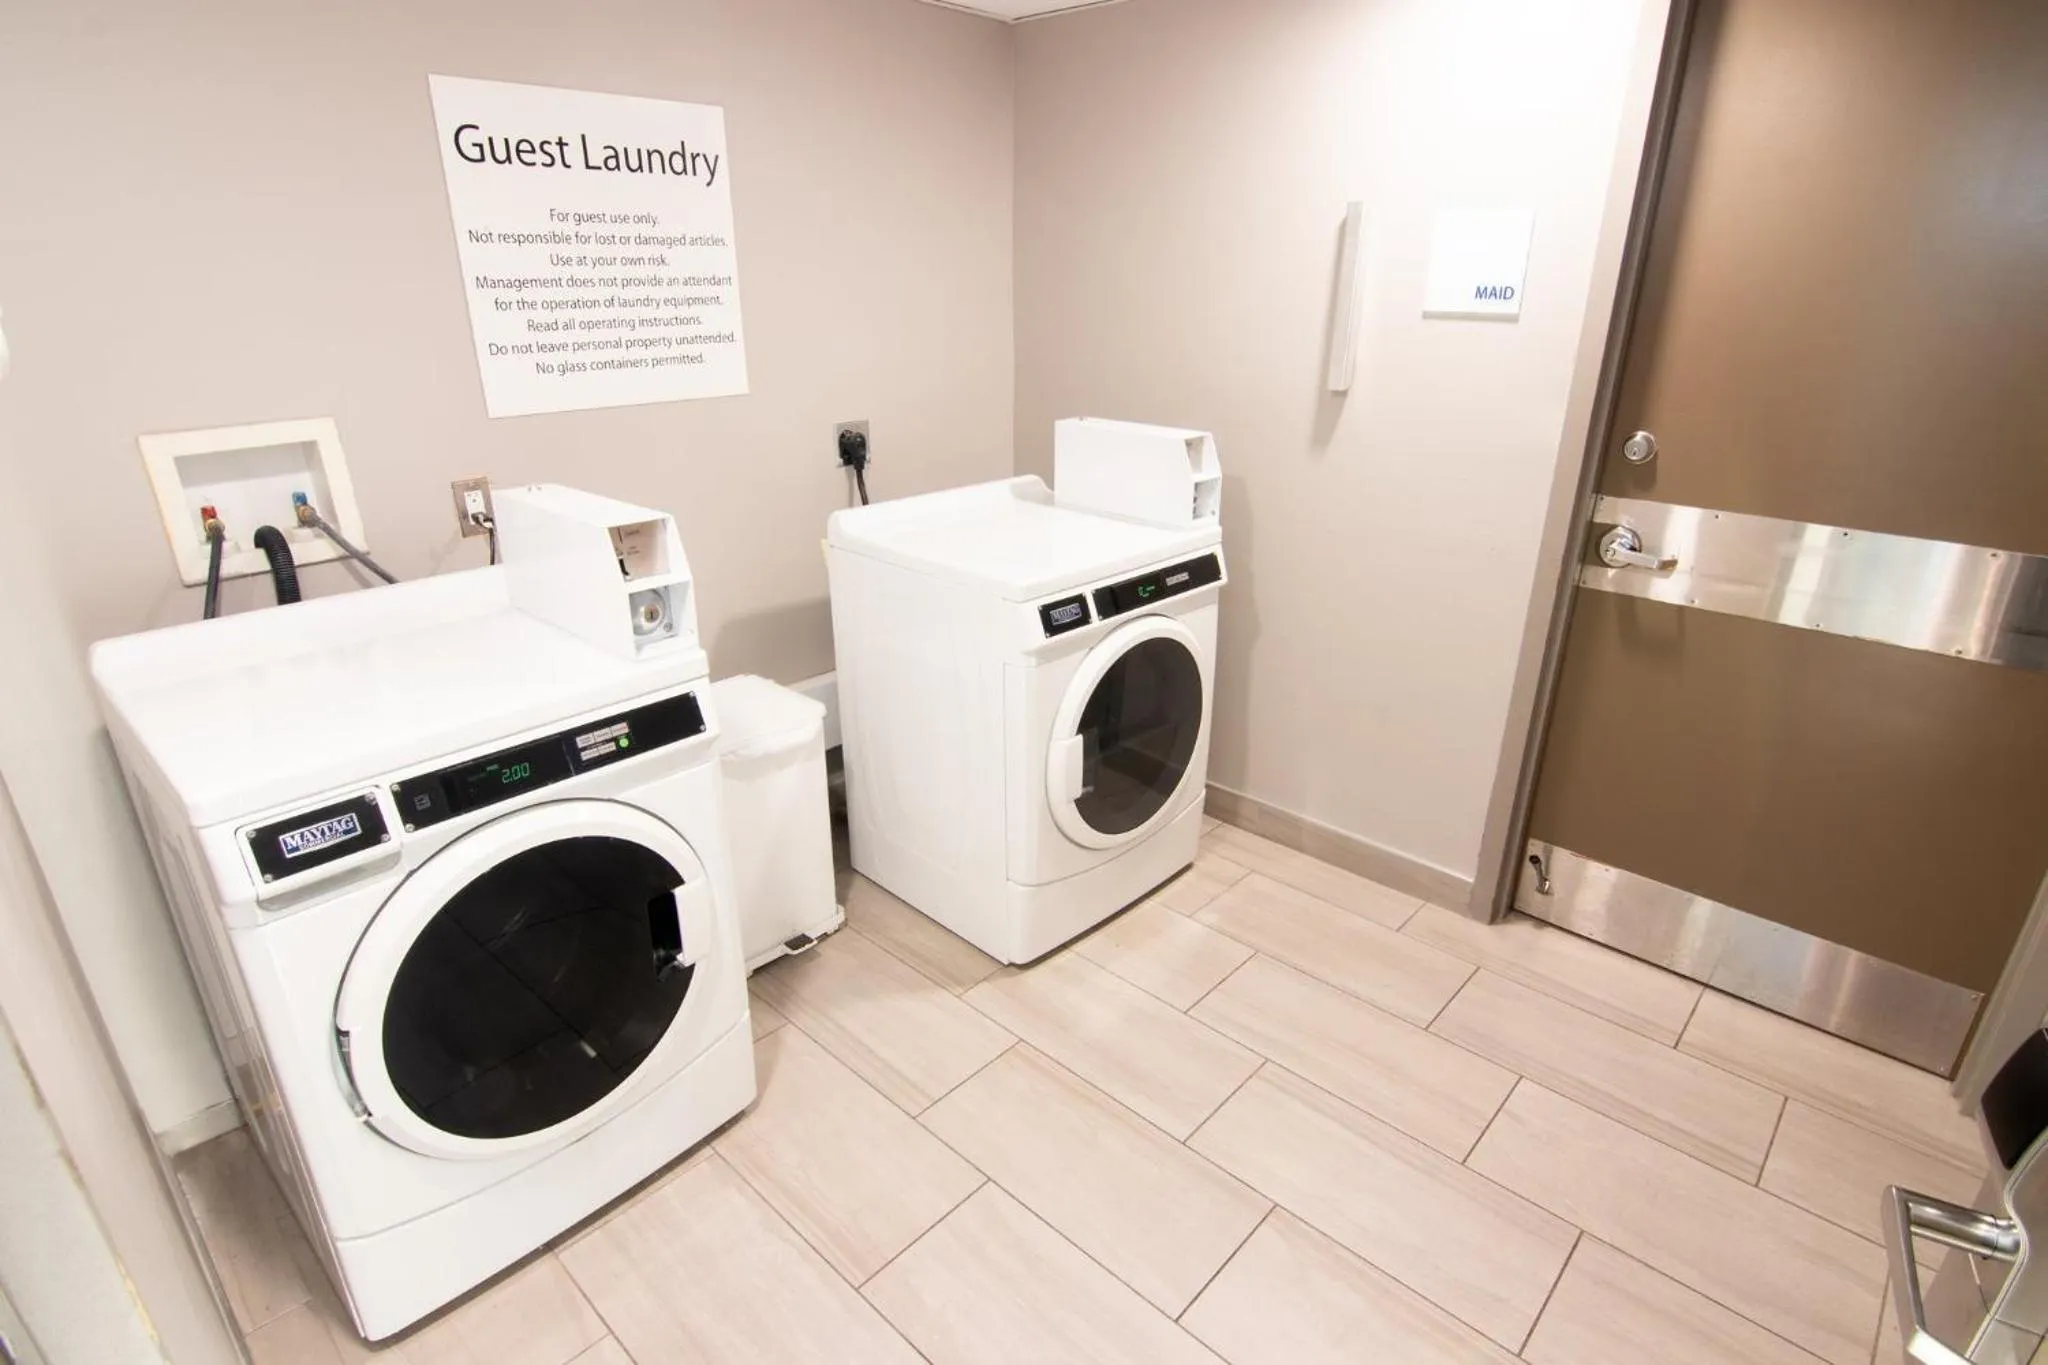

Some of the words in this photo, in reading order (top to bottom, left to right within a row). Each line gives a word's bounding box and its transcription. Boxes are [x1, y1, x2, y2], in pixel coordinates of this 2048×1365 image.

[453, 123, 572, 169] Guest
[580, 133, 719, 187] Laundry
[549, 208, 570, 222] For
[573, 211, 607, 226] guest
[610, 213, 630, 224] use
[633, 212, 659, 228] only.
[468, 229, 494, 244] Not
[498, 231, 572, 247] responsible
[575, 231, 592, 244] for
[595, 232, 617, 246] lost
[620, 235, 632, 246] or
[634, 233, 686, 250] damaged
[689, 234, 728, 247] articles.
[550, 253, 573, 266] Use
[576, 255, 588, 266] at
[591, 256, 617, 269] your
[620, 256, 645, 266] own
[648, 254, 669, 266] risk.
[475, 275, 563, 292] Management
[566, 275, 595, 288] does
[599, 275, 618, 287] not
[622, 274, 664, 290] provide
[666, 277, 679, 287] an
[682, 274, 732, 287] attendant
[1474, 285, 1515, 301] MAID
[494, 297, 513, 311] for
[516, 298, 538, 311] the
[541, 296, 600, 312] operation
[603, 295, 616, 309] of
[618, 294, 660, 309] laundry
[663, 294, 723, 309] equipment.
[527, 318, 559, 332] Read
[562, 318, 576, 331] all
[579, 316, 636, 332] operating
[638, 314, 703, 328] instructions.
[488, 342, 509, 356] Do
[512, 343, 533, 355] not
[536, 340, 569, 353] leave
[572, 337, 622, 354] personal
[625, 336, 672, 351] property
[675, 331, 736, 346] unattended.
[536, 361, 555, 375] No
[557, 361, 588, 376] glass
[590, 357, 649, 371] containers
[651, 352, 706, 368] permitted.
[501, 762, 531, 784] 2.00
[285, 817, 355, 850] MAYTAG
